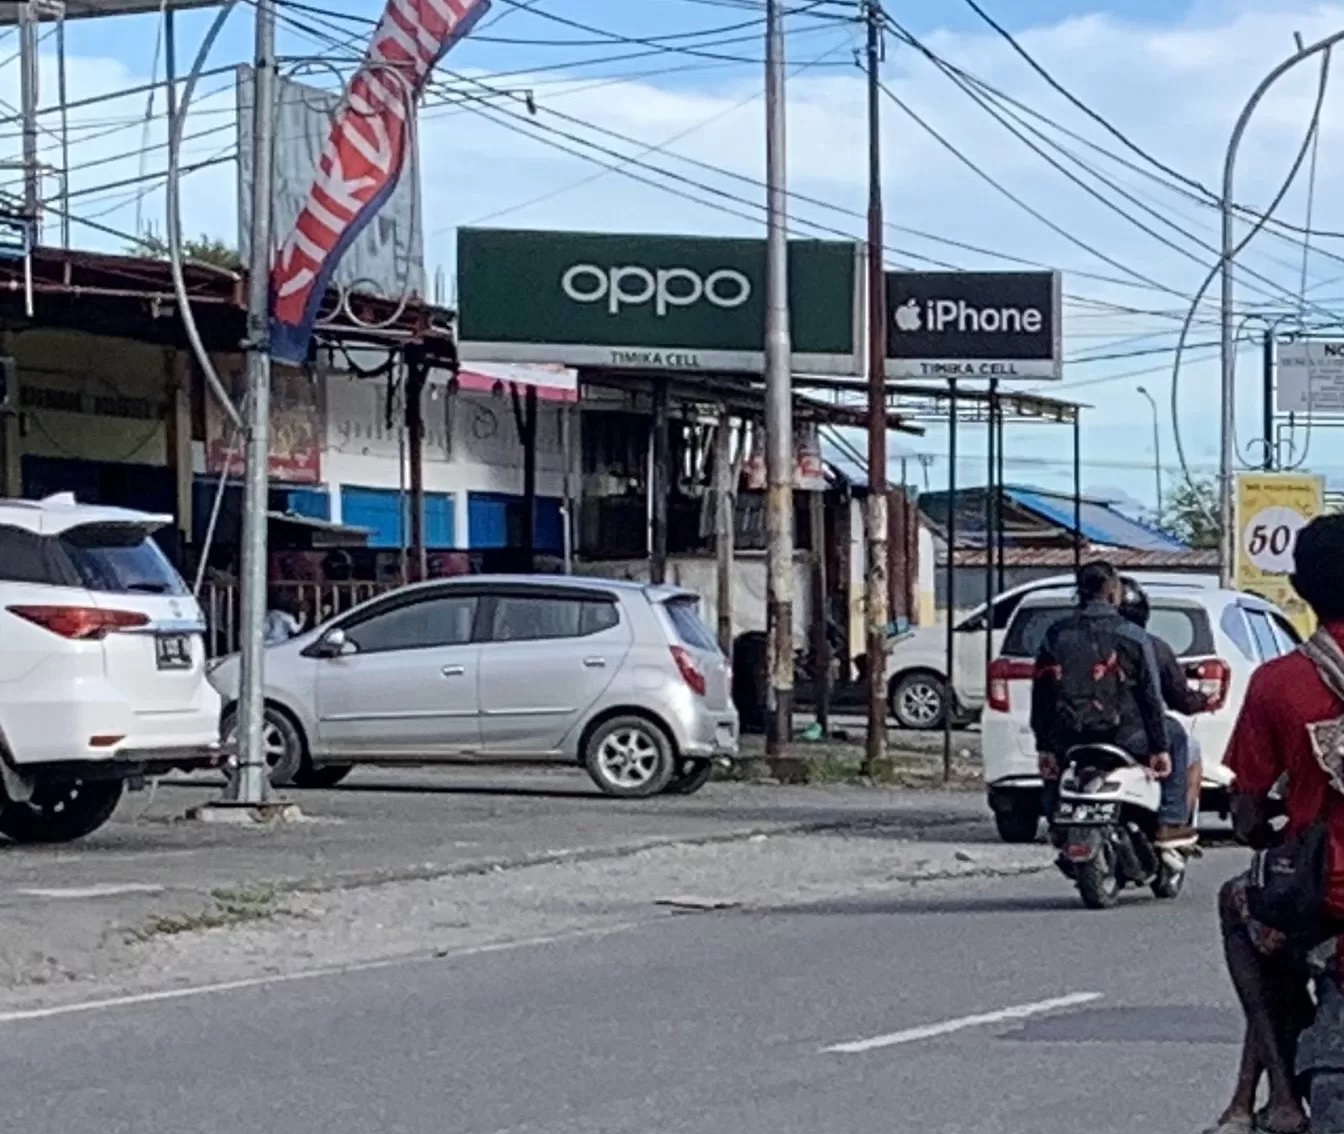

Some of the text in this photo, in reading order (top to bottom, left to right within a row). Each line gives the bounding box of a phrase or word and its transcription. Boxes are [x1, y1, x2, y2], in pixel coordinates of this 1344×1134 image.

[562, 264, 750, 315] oppo
[927, 299, 1042, 332] iPhone
[611, 351, 700, 367] TIMIKA CELL
[920, 363, 1017, 374] TIMIKA CELL
